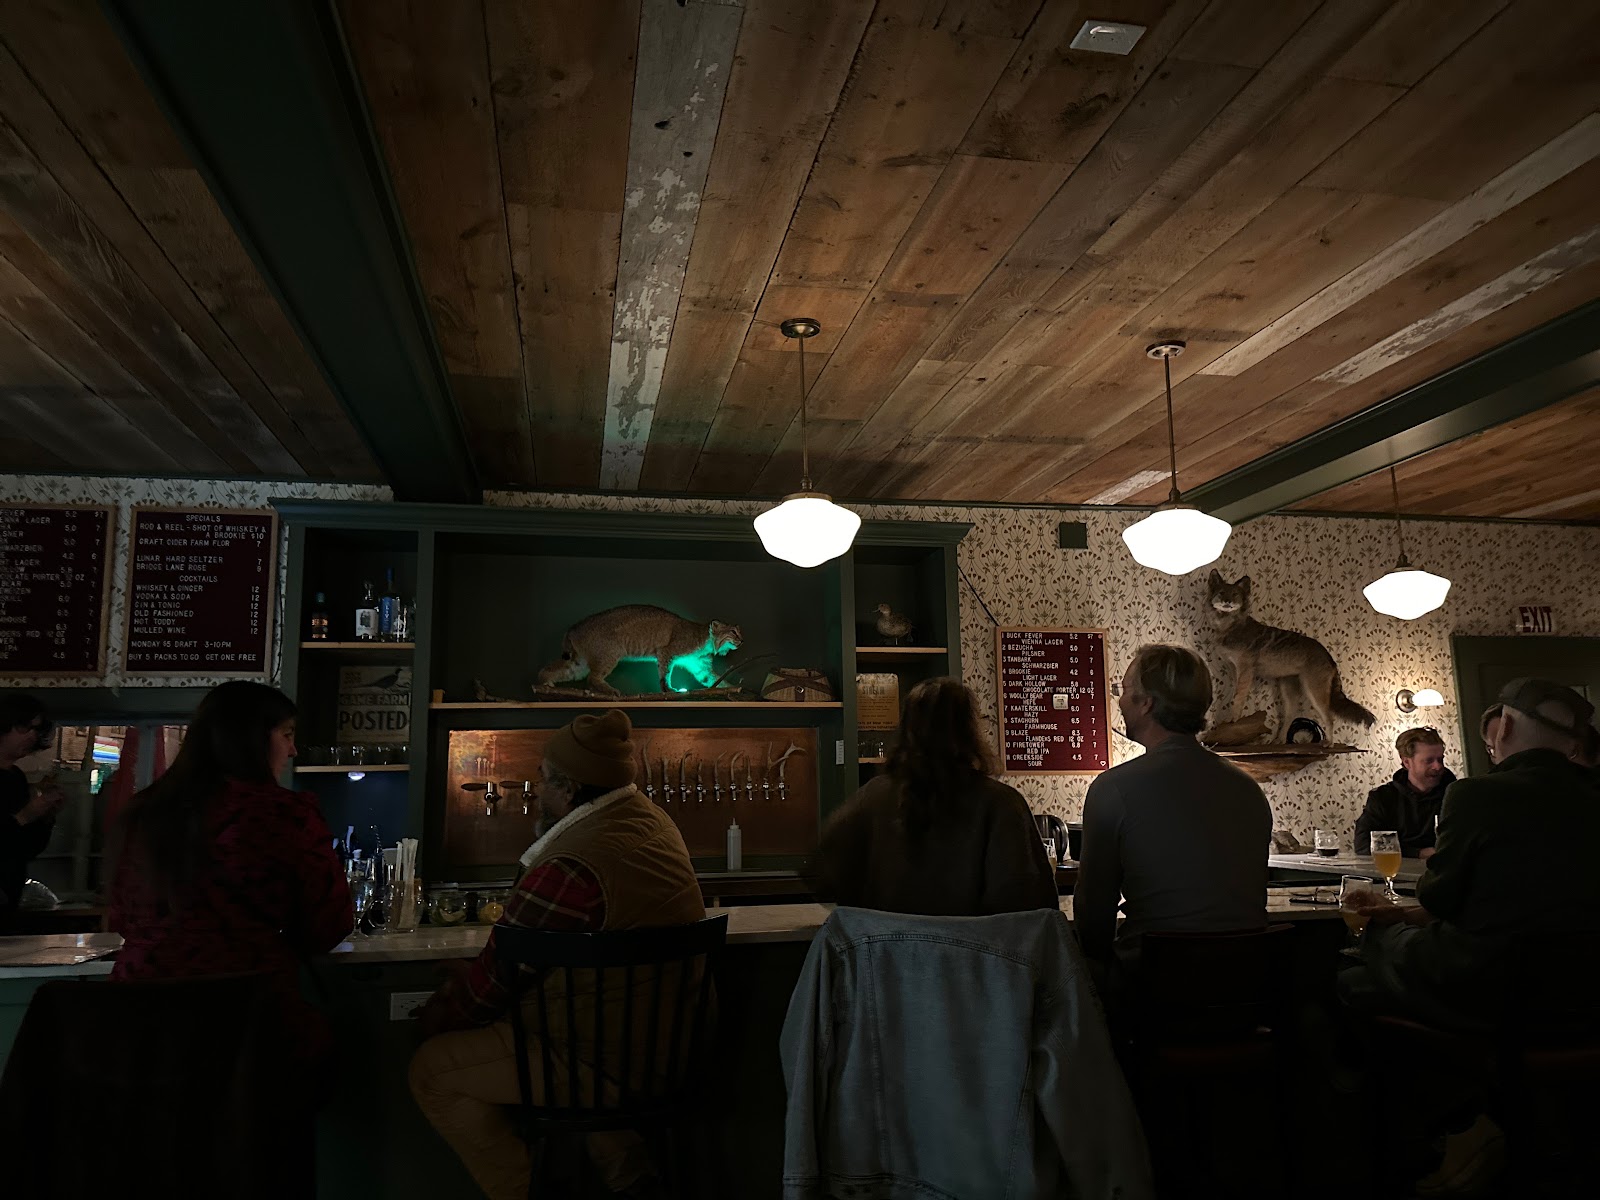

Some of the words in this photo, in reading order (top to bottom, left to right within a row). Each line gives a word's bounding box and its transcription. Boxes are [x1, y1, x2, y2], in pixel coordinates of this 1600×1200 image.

[225, 525, 259, 533] WHISKEY
[212, 539, 230, 547] FLOR
[257, 558, 262, 566] 7
[1519, 607, 1552, 632] EXIT
[377, 694, 408, 705] FARM
[339, 711, 407, 730] POSTED
